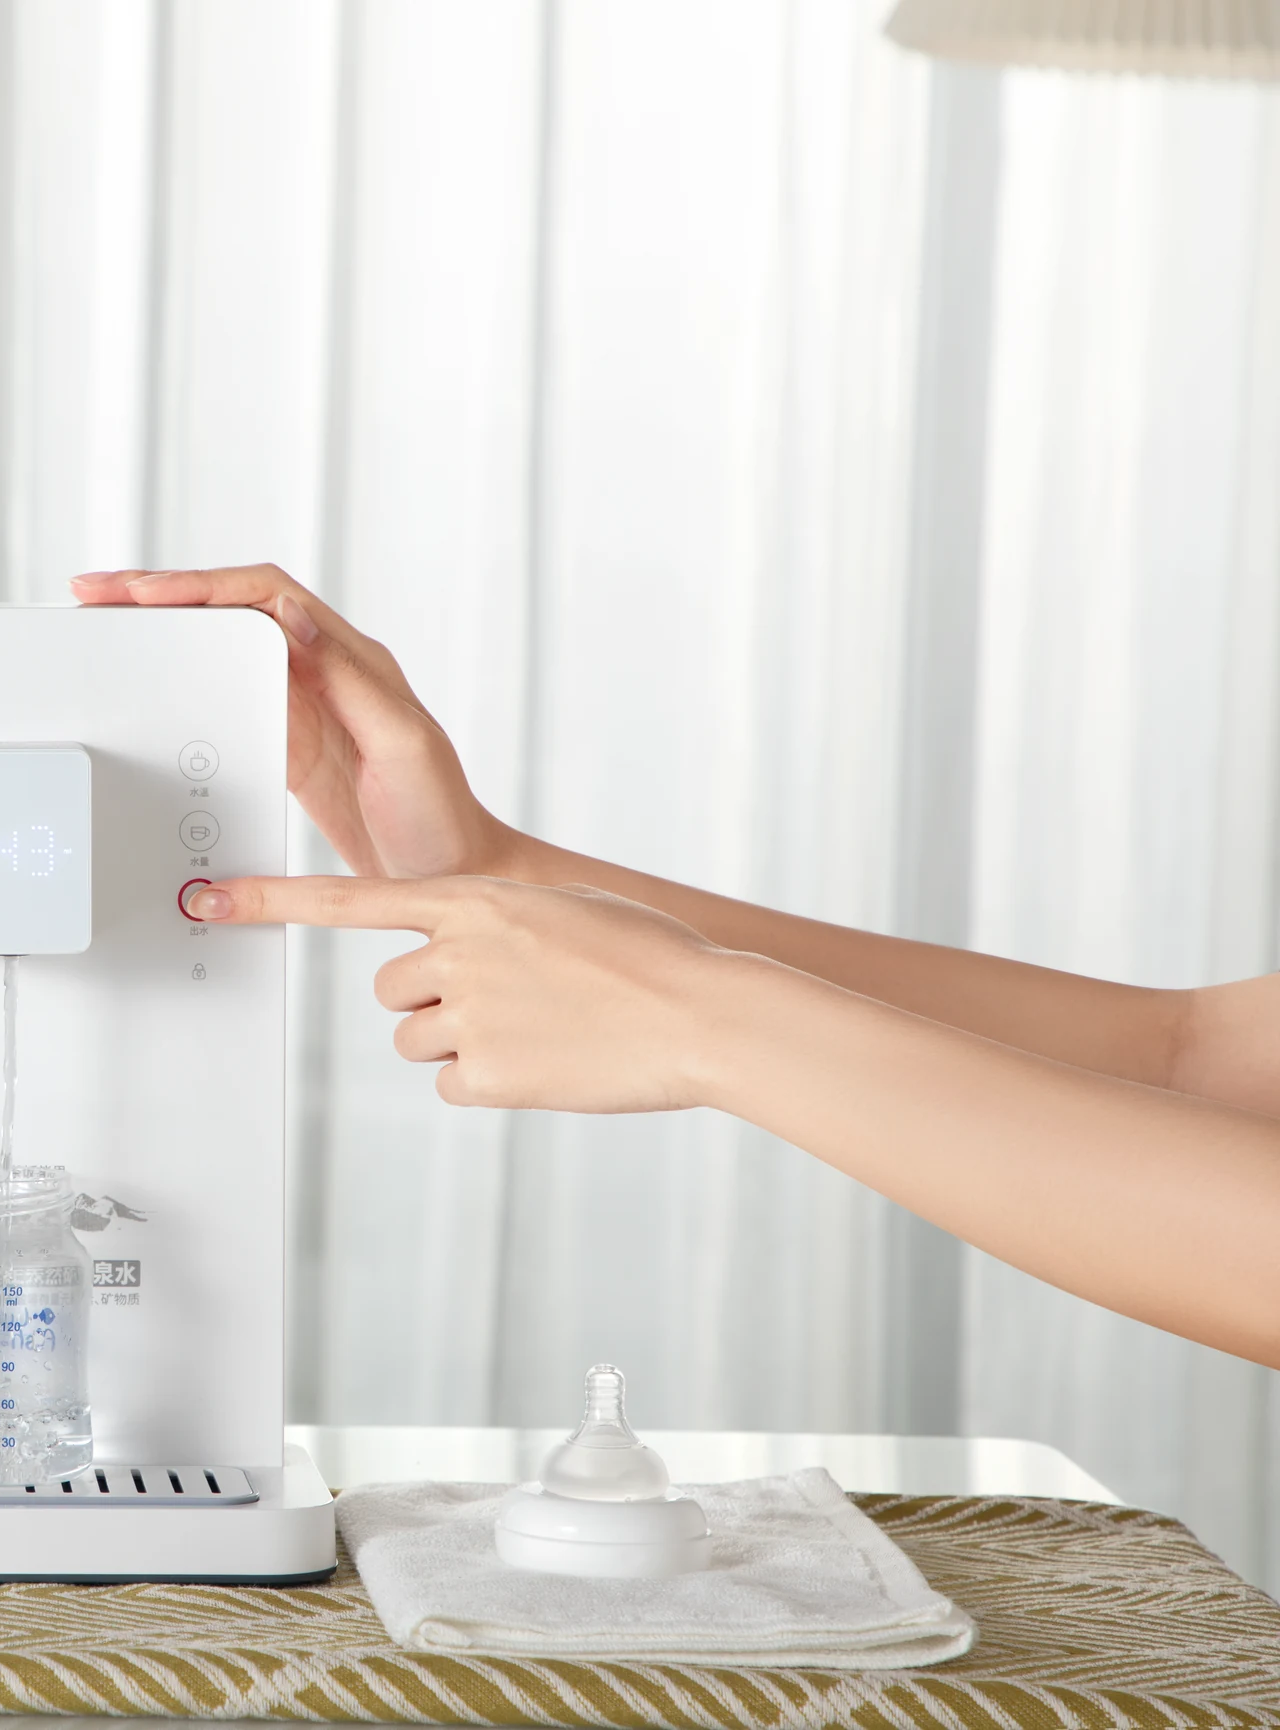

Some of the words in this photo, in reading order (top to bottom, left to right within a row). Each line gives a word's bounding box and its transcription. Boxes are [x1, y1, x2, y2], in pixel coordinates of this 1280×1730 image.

[190, 788, 209, 797] 水温
[190, 857, 209, 867] 水量
[190, 926, 208, 936] 出水
[2, 1287, 23, 1296] 150
[6, 1298, 18, 1306] ml
[1, 1322, 21, 1332] 120
[1, 1362, 15, 1372] 90
[1, 1400, 15, 1409] 60
[1, 1438, 15, 1447] 30
